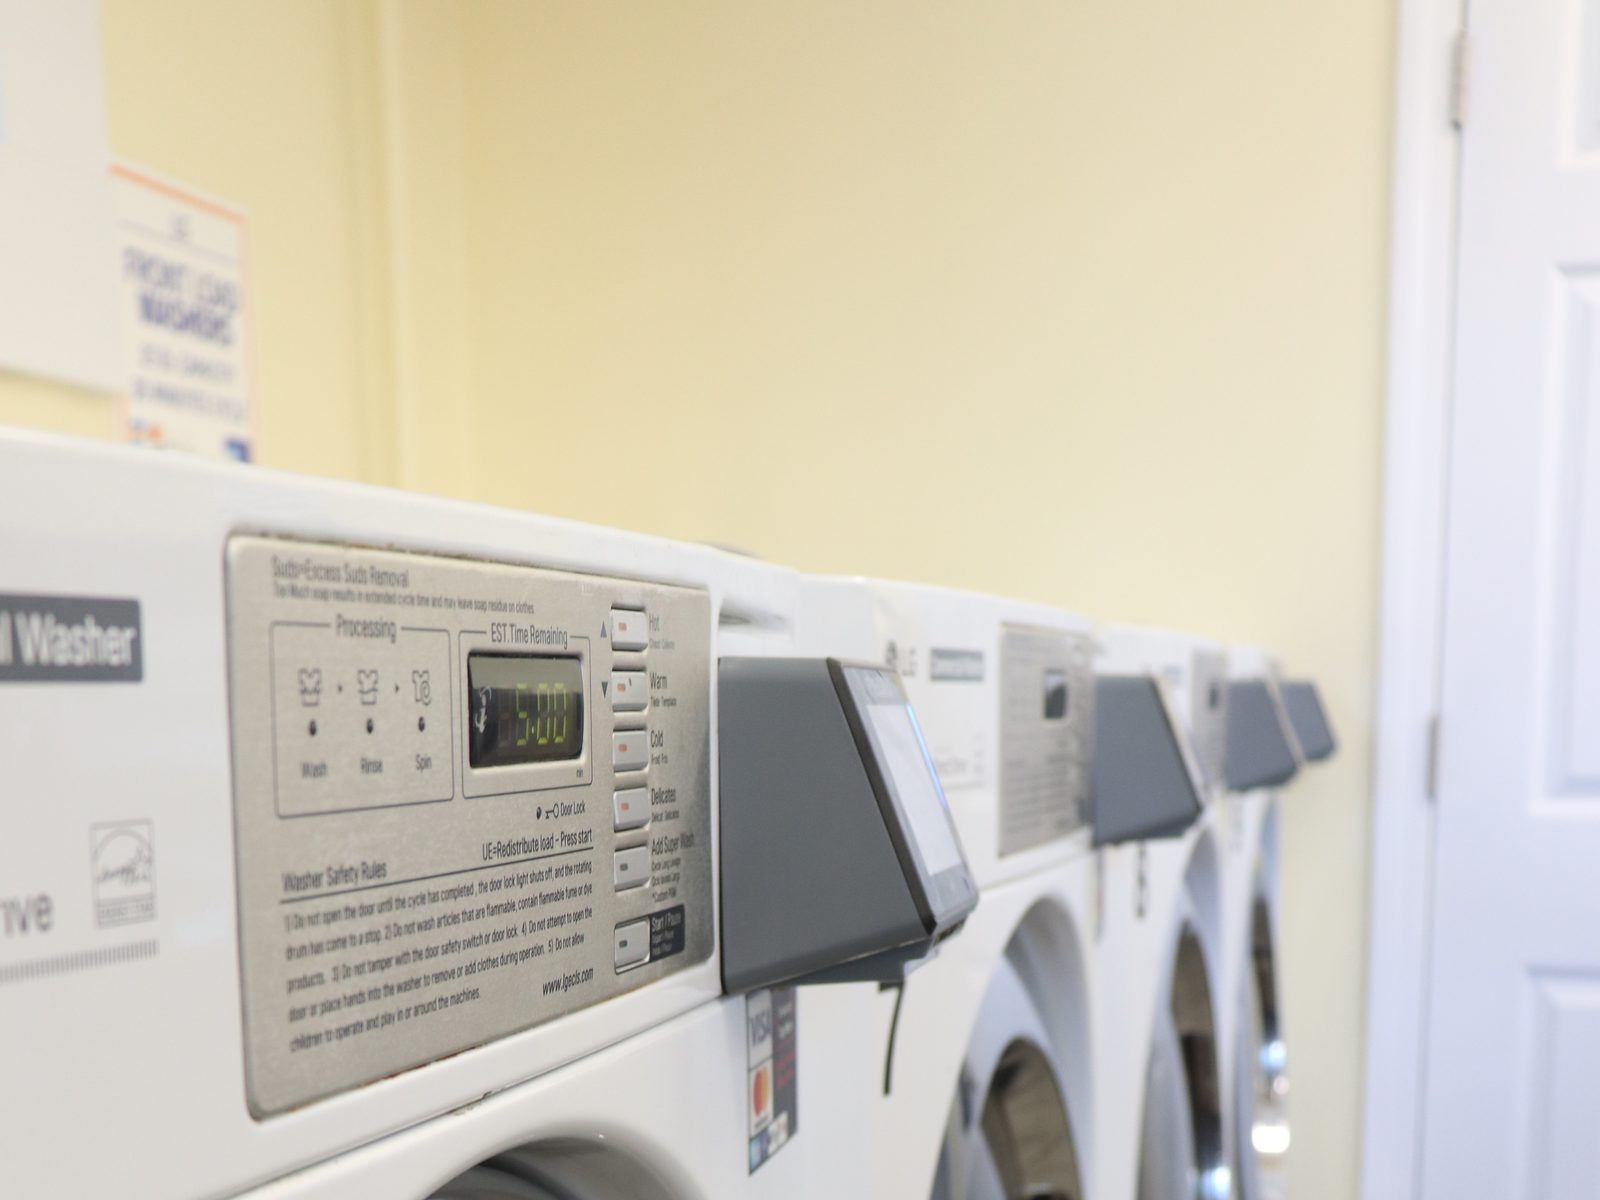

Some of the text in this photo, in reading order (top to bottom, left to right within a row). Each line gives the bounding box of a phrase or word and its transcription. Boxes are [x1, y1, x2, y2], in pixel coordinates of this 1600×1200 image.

[369, 564, 409, 589] Removal
[416, 594, 429, 607] time
[432, 595, 443, 608] and
[444, 597, 456, 611] may
[458, 598, 472, 610] leave
[474, 600, 487, 614] soap
[488, 599, 507, 613] residue
[336, 614, 397, 643] Processing
[649, 613, 660, 631] Hot
[15, 610, 137, 666] Washer
[530, 625, 568, 650] Remaining
[650, 672, 667, 690] Warm
[650, 730, 664, 748] Cold
[360, 757, 383, 774] Rinse
[415, 754, 432, 773] Spin
[560, 800, 586, 817] Door Lock
[651, 788, 677, 806] Delicates
[540, 832, 554, 850] load
[560, 831, 577, 848] Press
[578, 827, 593, 844] start
[651, 838, 664, 856] Add
[664, 836, 680, 855] Super
[282, 861, 388, 892] Washer Safety Rules
[344, 905, 356, 920] the
[359, 903, 376, 918] door
[377, 899, 393, 915] until
[395, 896, 406, 911] the
[408, 891, 426, 910] cycle
[427, 890, 440, 906] has
[478, 879, 488, 893] the
[490, 876, 503, 892] door
[504, 873, 515, 889] lock
[516, 871, 529, 889] light
[529, 869, 544, 884] shuts
[554, 864, 564, 879] and
[565, 863, 573, 876] the
[573, 860, 592, 876] rotating
[393, 922, 402, 938] Do
[404, 920, 415, 935] not
[417, 917, 435, 932] wash
[436, 912, 461, 929] articles
[461, 908, 474, 922] that
[475, 907, 485, 919] are
[518, 895, 539, 911] contain
[539, 886, 565, 905] flammable
[565, 885, 577, 898] fume
[583, 882, 592, 897] dye
[367, 956, 392, 974] tamper
[395, 951, 411, 967] with
[412, 948, 423, 962] the
[424, 943, 439, 960] door
[441, 939, 461, 957] safety
[462, 934, 483, 951] switch
[492, 928, 505, 943] door
[529, 919, 536, 934] Do
[537, 917, 546, 931] not
[546, 914, 567, 930] attempt
[573, 909, 584, 924] open
[343, 990, 366, 1008] hands
[368, 985, 381, 1001] into
[383, 982, 395, 998] the
[396, 976, 422, 994] washer
[431, 968, 456, 985] remove
[464, 961, 477, 977] add
[477, 955, 499, 973] clothes
[499, 949, 518, 967] during
[555, 937, 562, 950] Do
[562, 935, 571, 948] not
[571, 932, 585, 947] allow
[289, 1032, 322, 1052] children
[335, 1020, 363, 1040] operate
[366, 1015, 379, 1031] and
[381, 1011, 395, 1030] play
[413, 997, 437, 1017] around
[438, 996, 449, 1011] the
